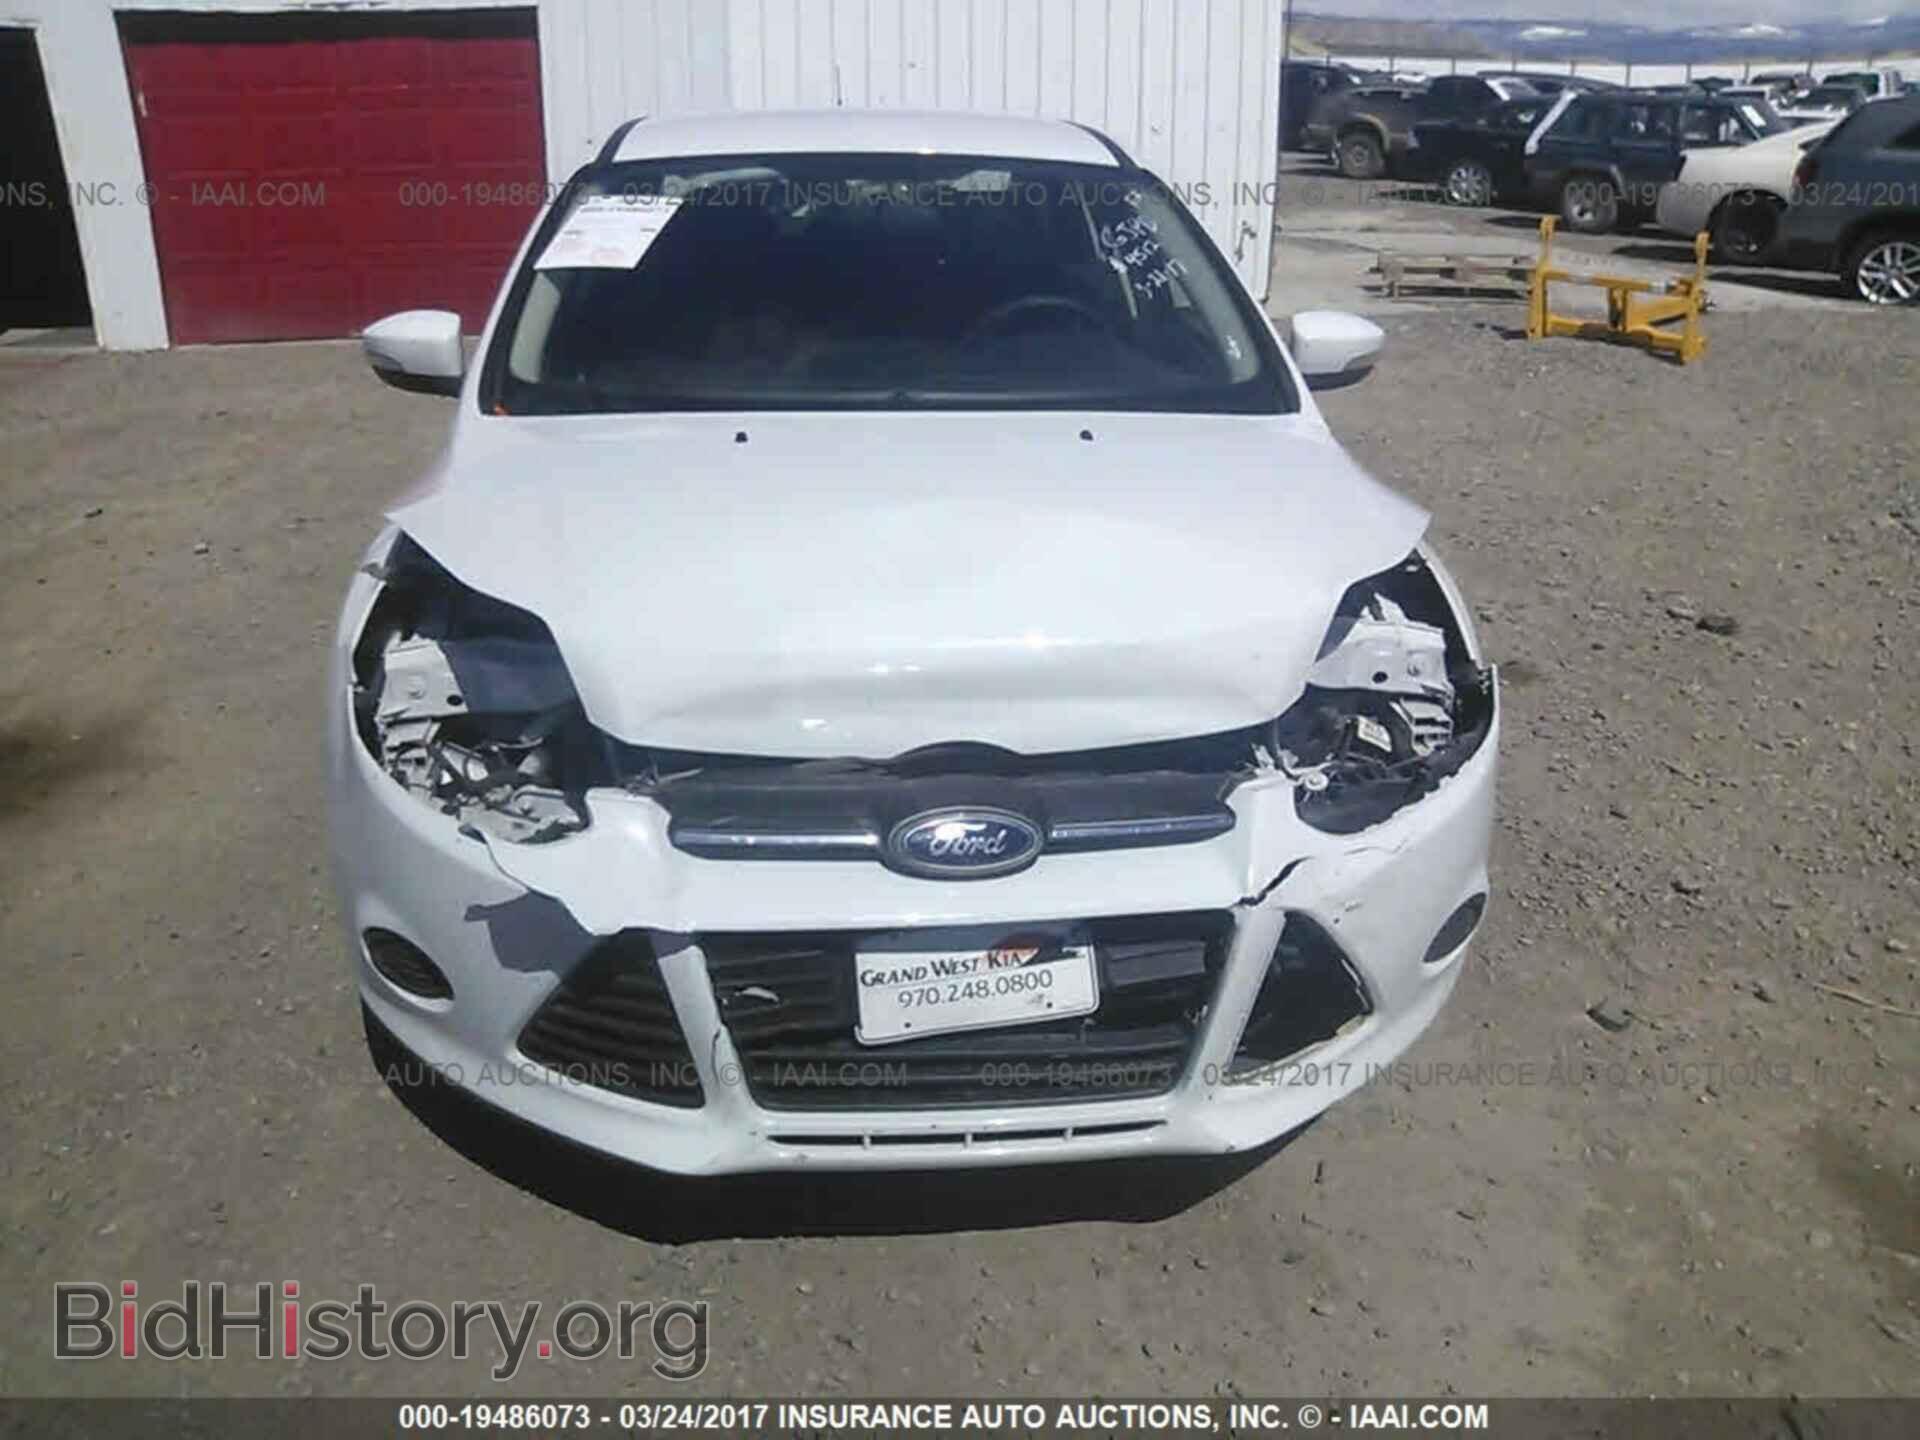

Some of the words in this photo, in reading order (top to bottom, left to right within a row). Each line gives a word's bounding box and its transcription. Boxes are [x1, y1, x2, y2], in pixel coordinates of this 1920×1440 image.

[914, 823, 1008, 857] Ford
[860, 965, 928, 987] GRAND
[930, 957, 980, 978] WEST
[987, 949, 1024, 970] KIA
[898, 968, 1054, 1009] 970.248.0800
